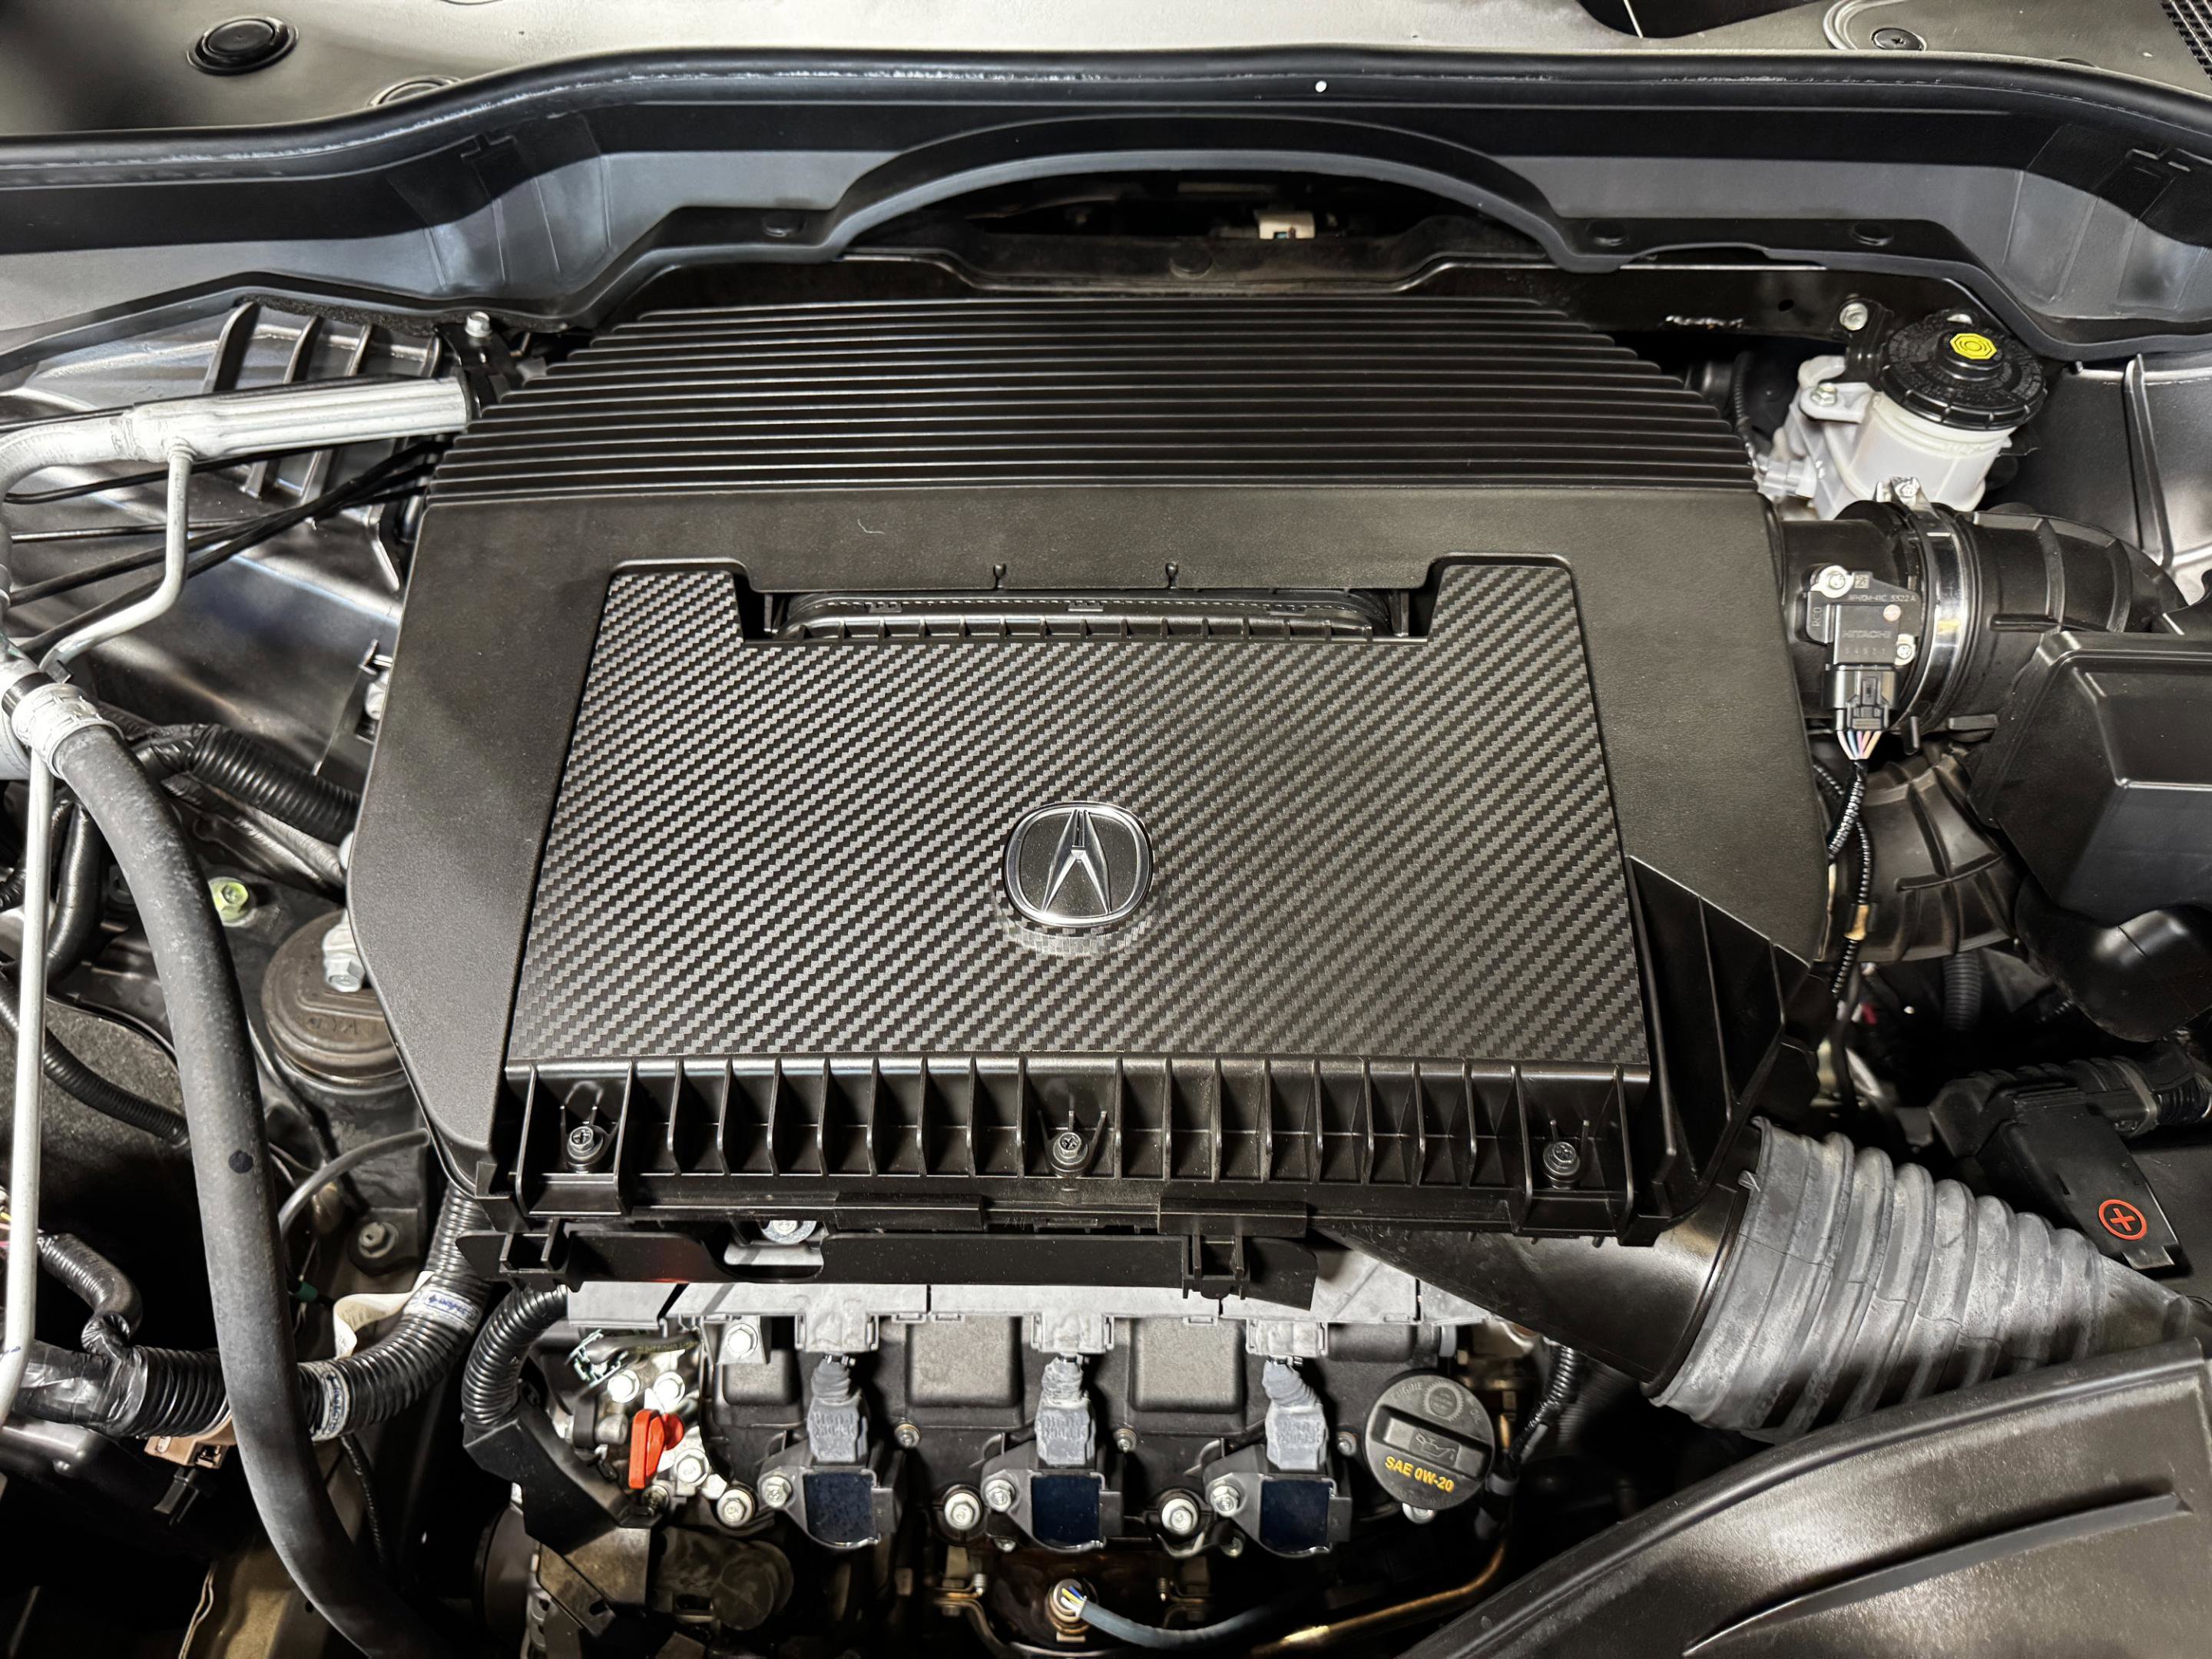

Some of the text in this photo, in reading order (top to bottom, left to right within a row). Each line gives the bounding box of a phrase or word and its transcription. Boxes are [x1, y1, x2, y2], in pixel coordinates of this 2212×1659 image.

[1842, 629, 1891, 639] HITACHI
[1390, 1382, 1423, 1402] ENGINE
[1469, 1408, 1482, 1426] OIL
[1385, 1455, 1455, 1493] SAE 0W-20
